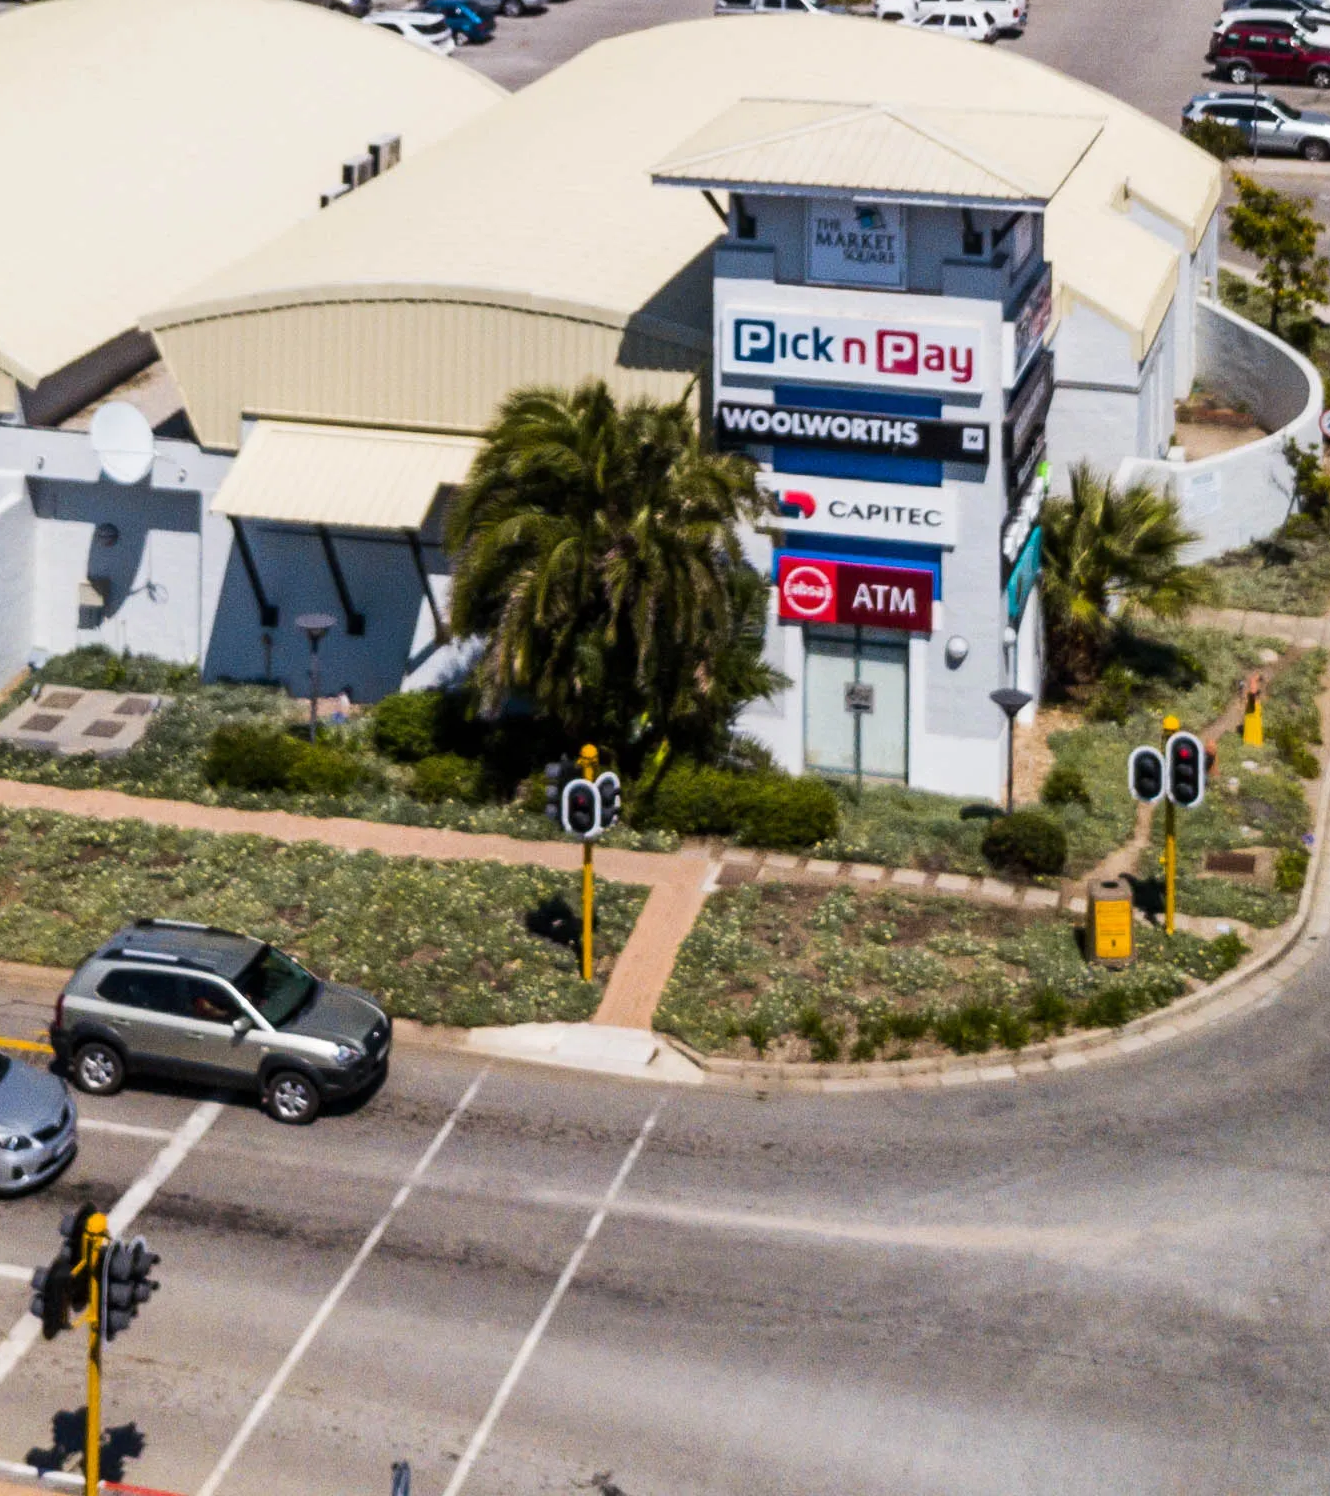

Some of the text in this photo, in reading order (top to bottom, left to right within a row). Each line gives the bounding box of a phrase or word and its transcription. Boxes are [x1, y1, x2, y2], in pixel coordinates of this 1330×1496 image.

[816, 231, 895, 251] MARKET
[733, 318, 974, 384] Pick n Pay
[722, 406, 919, 445] WOOLWORTHS
[828, 501, 943, 527] CAPITEC
[852, 582, 917, 617] ATM
